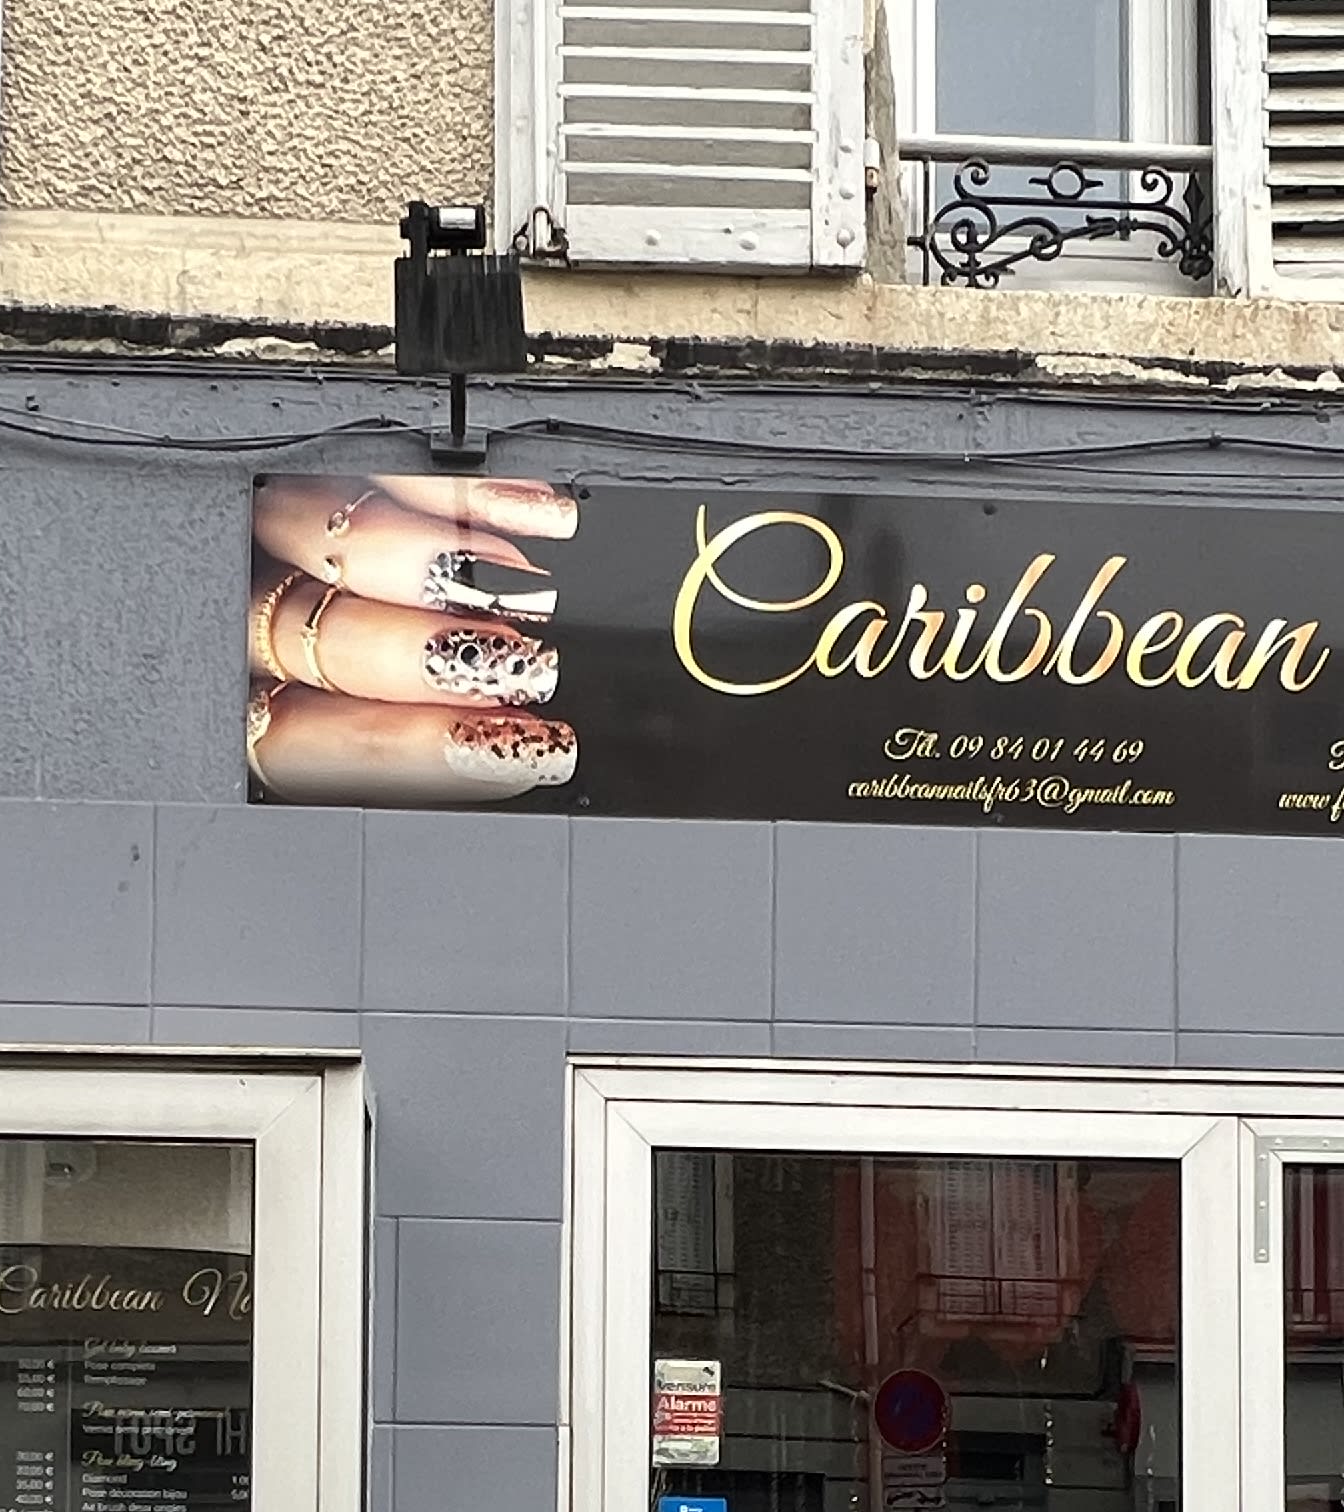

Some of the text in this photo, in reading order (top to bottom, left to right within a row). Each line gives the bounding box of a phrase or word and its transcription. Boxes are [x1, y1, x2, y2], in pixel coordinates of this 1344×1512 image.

[672, 504, 1328, 696] Caribbean
[949, 735, 984, 760] 09
[990, 737, 1024, 761] 84
[1031, 738, 1064, 762] 01
[1072, 739, 1105, 763] 44
[1112, 739, 1145, 763] 69
[848, 774, 1175, 814] caribbeannailsfr63@gmail.com
[657, 1396, 717, 1412] Alarme
